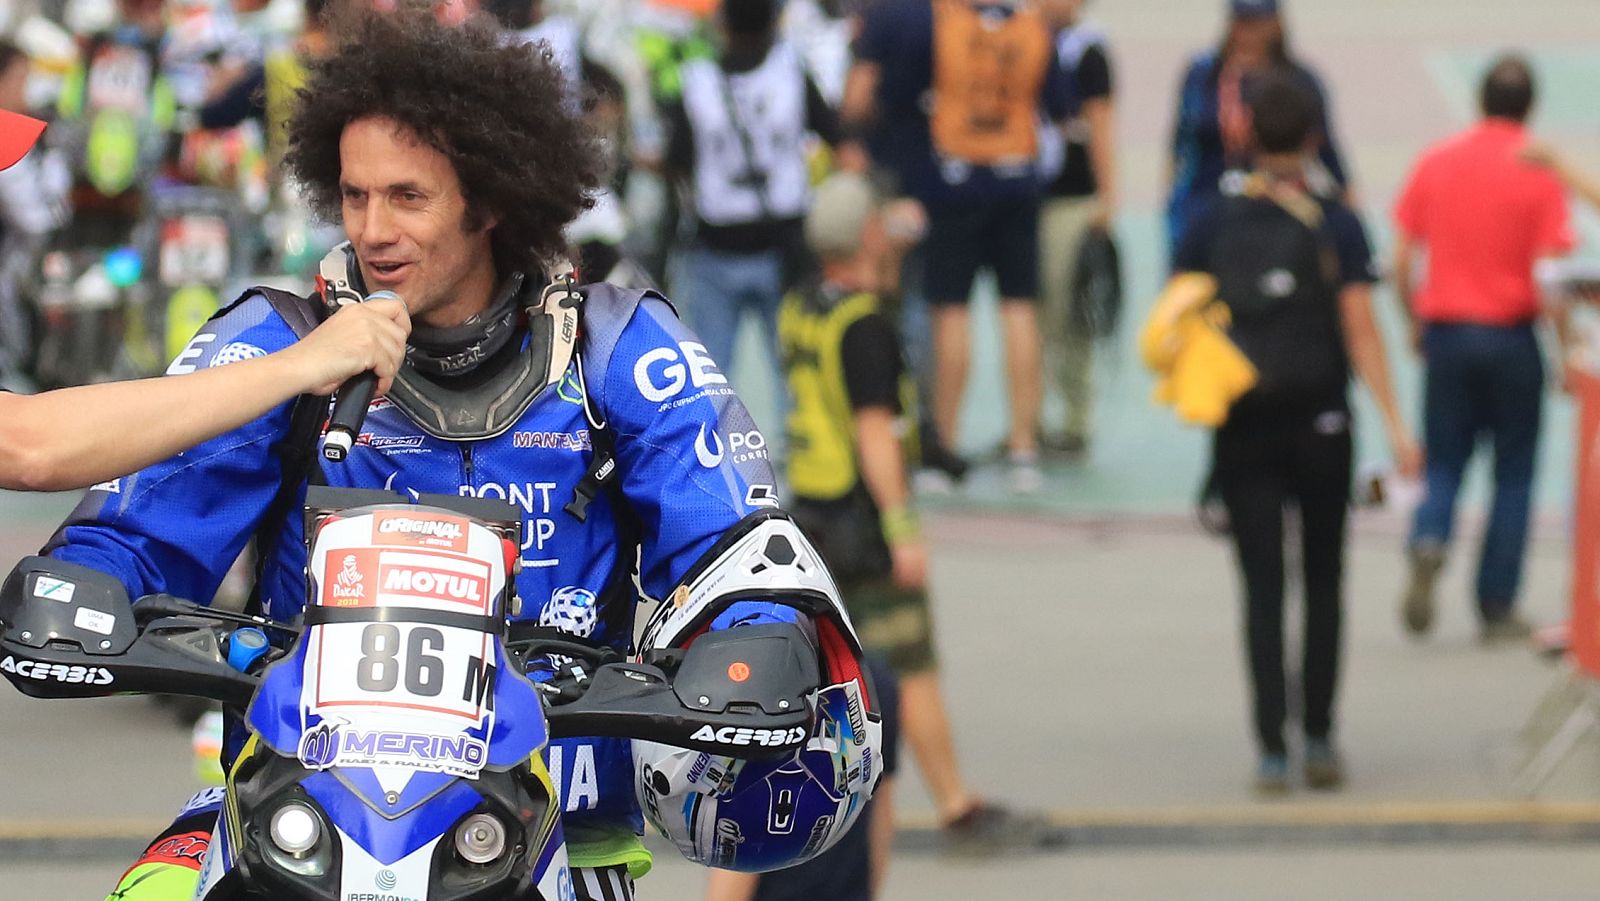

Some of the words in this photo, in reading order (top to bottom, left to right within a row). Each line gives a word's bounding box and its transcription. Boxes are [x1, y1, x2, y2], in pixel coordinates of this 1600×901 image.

[561, 312, 574, 345] LEATT
[379, 518, 463, 539] ORIGINAL
[332, 583, 366, 598] DAKAR
[383, 568, 481, 601] MOTUL
[336, 598, 359, 606] 2018
[0, 656, 115, 685] ACERBIS
[356, 623, 445, 697] 86
[463, 655, 497, 711] M
[848, 690, 865, 738] YAMAHA
[344, 731, 485, 765] MERINO
[690, 725, 807, 746] ACERBIS
[393, 760, 443, 770] RALLY
[446, 765, 478, 777] TEAM
[706, 767, 723, 784] 86
